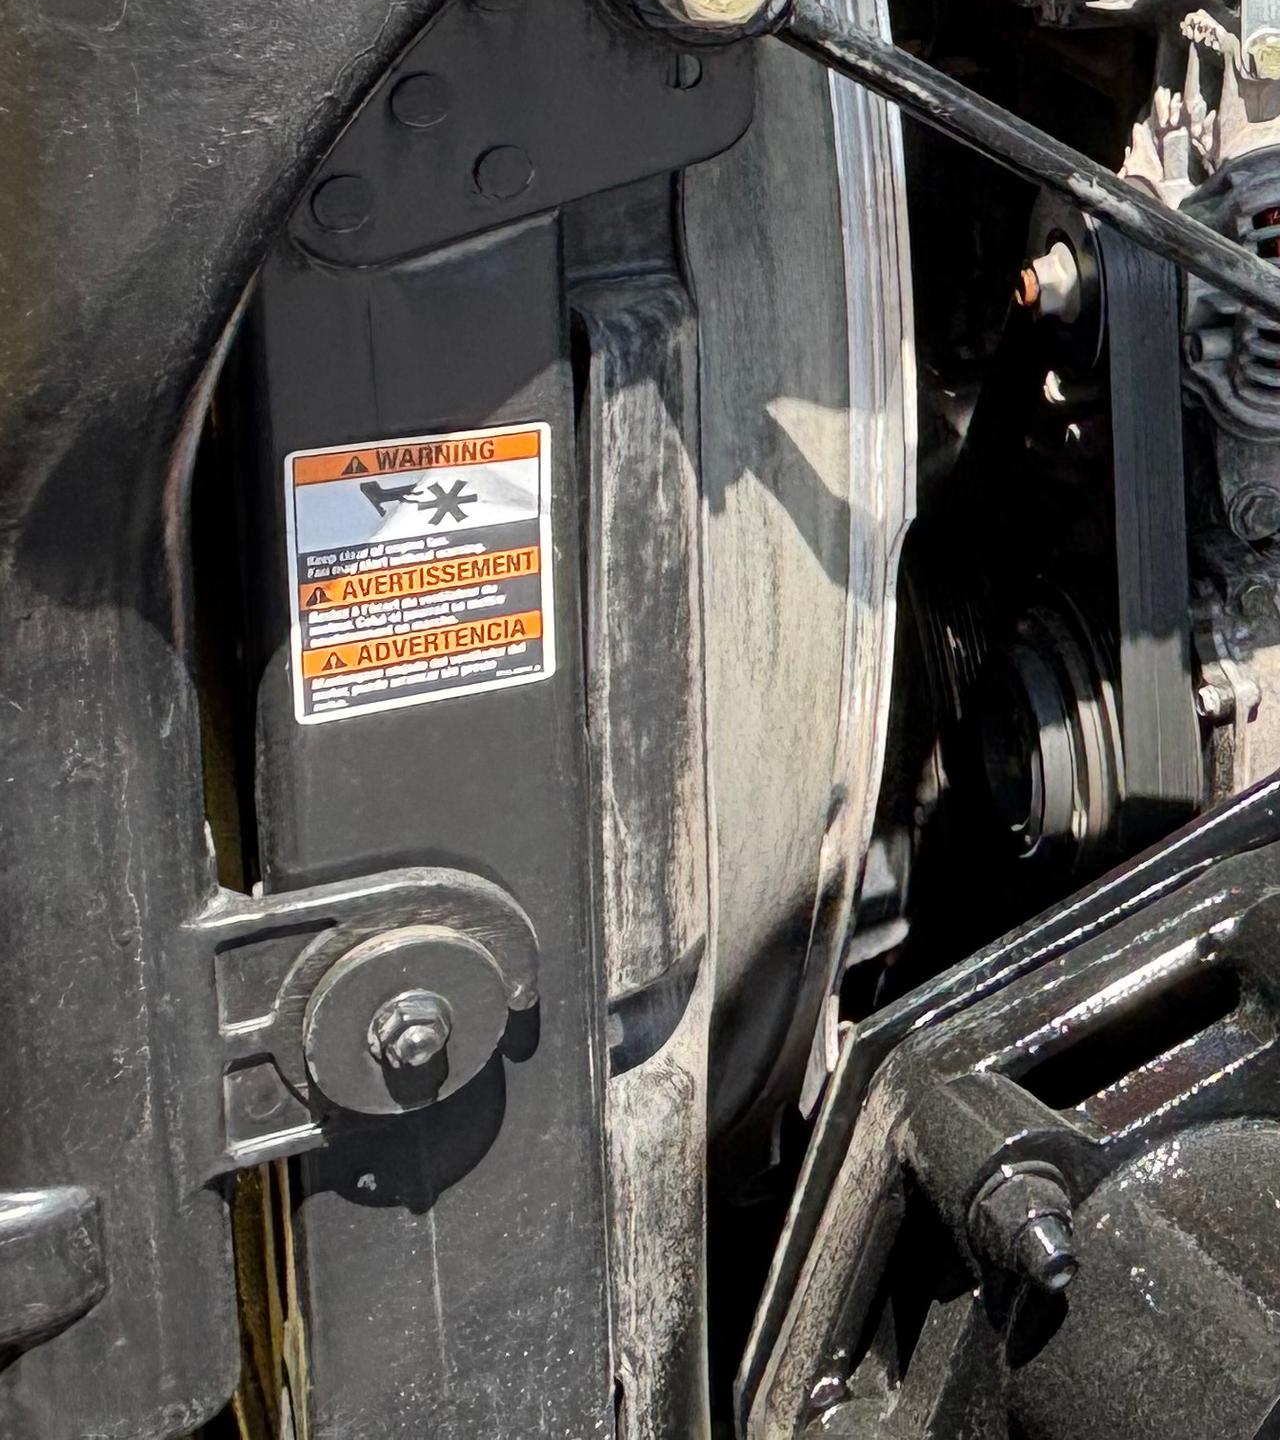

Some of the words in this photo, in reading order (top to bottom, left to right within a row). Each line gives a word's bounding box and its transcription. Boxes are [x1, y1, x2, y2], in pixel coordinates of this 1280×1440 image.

[376, 439, 495, 471] WARNING
[342, 550, 533, 601] AVERTISSEMENT
[356, 618, 527, 665] ADVERTENCIA
